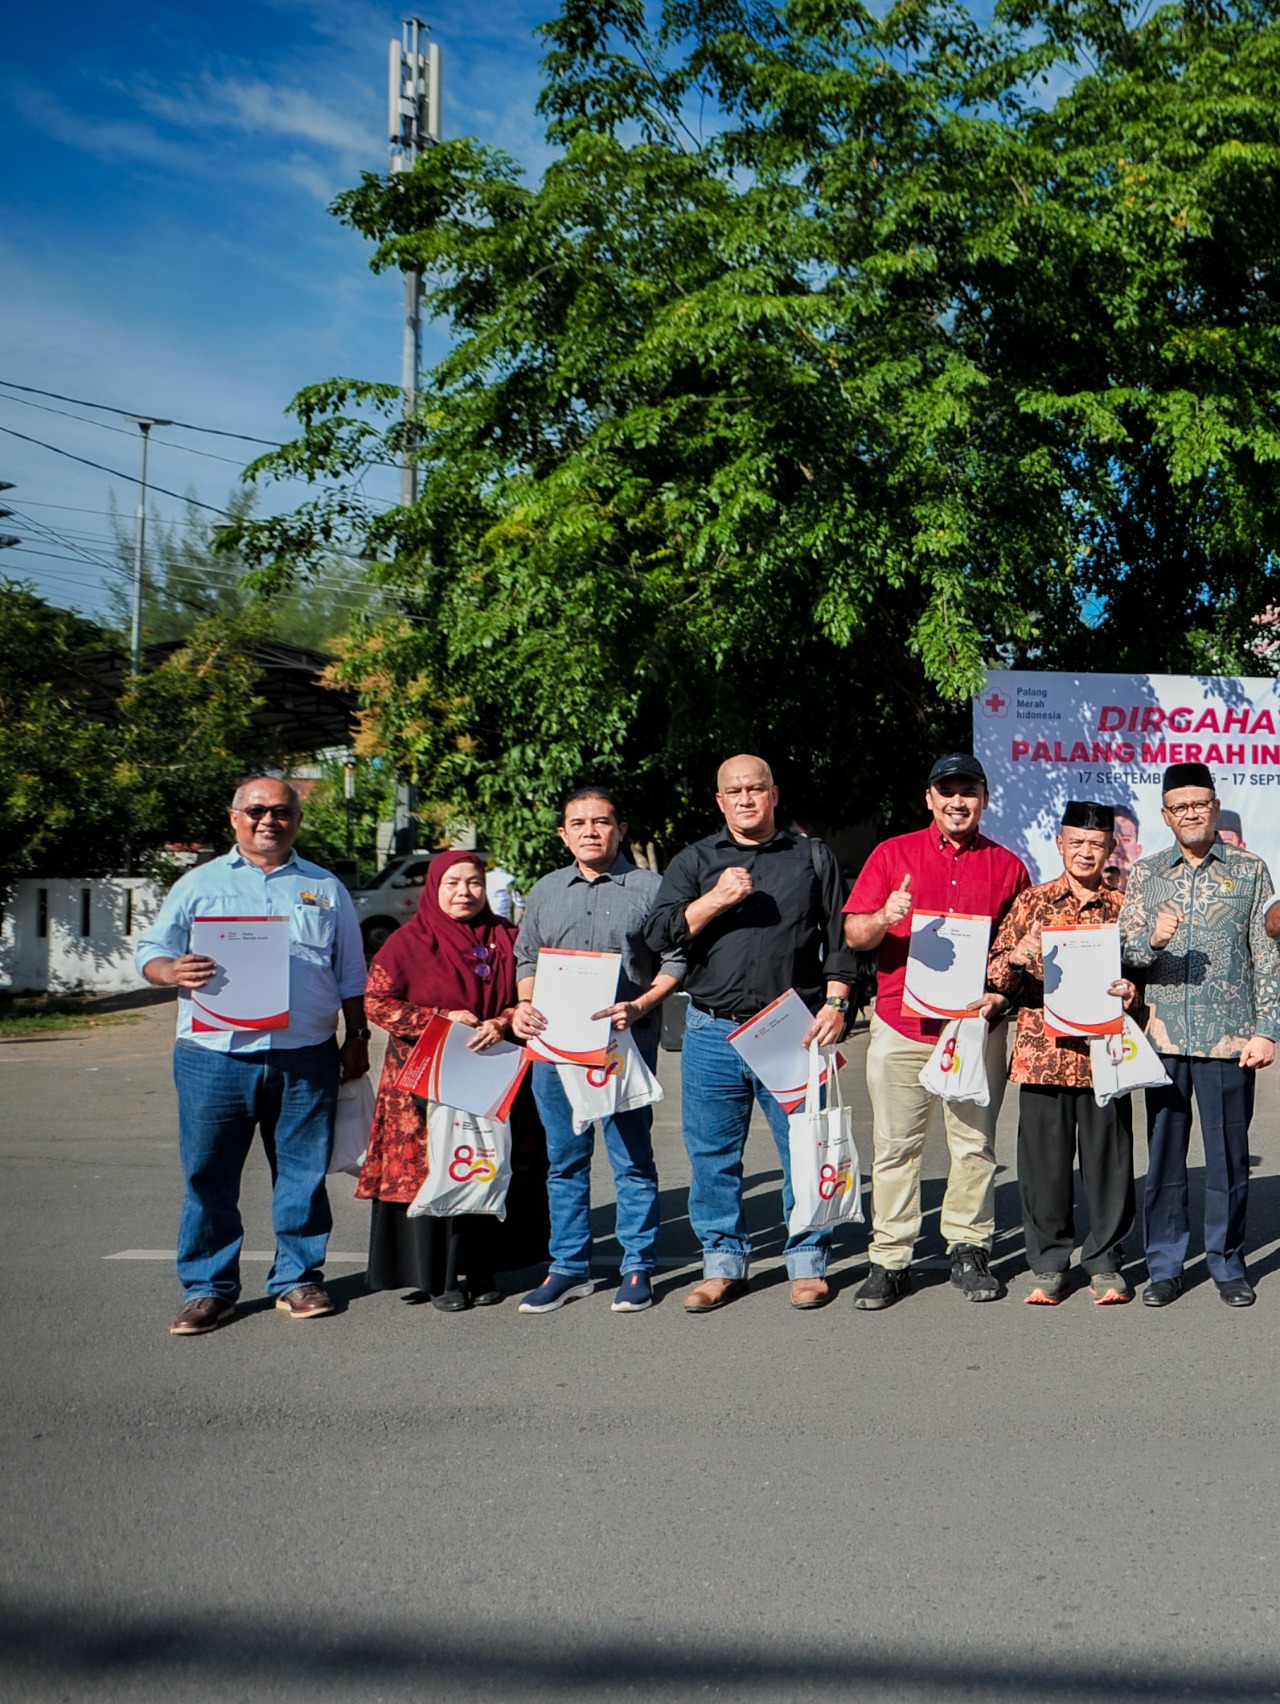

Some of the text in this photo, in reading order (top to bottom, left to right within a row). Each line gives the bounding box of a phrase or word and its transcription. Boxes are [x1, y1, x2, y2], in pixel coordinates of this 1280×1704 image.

[1016, 686, 1048, 698] Palang
[1016, 699, 1045, 709] Merah
[1016, 710, 1062, 720] Indonesia
[1011, 740, 1136, 763] PALANG
[1141, 742, 1246, 765] MERAH
[1078, 771, 1092, 784] 17
[1096, 771, 1163, 785] SEPTEMB
[1232, 773, 1246, 785] 17
